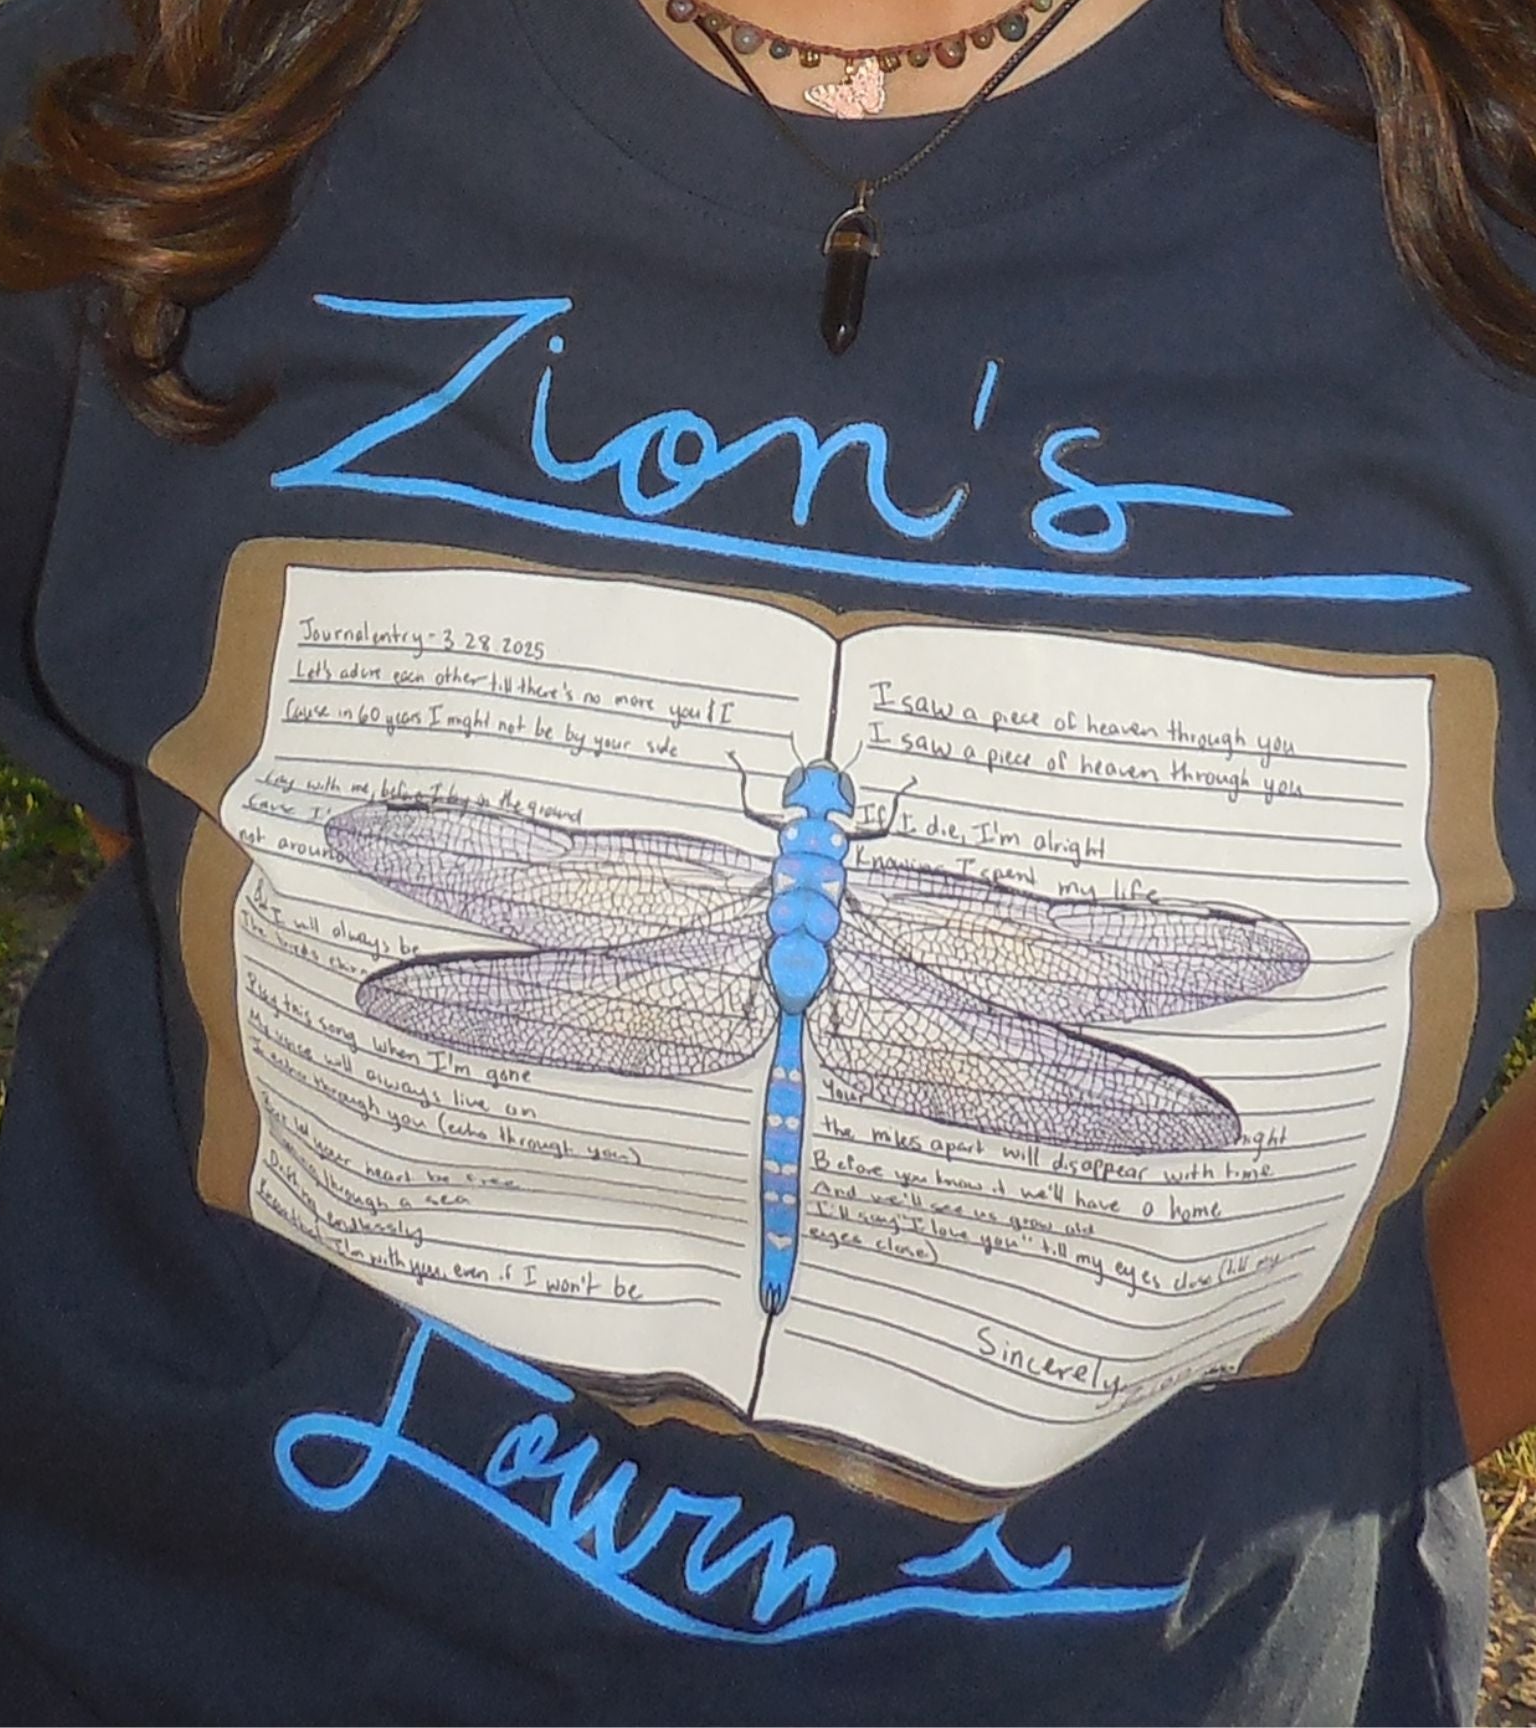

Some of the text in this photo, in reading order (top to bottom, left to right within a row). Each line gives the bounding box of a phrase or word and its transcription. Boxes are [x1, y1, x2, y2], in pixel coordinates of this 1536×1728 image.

[271, 293, 1470, 598] Zion's
[296, 658, 332, 680] Let's
[340, 662, 381, 680] adore
[393, 670, 424, 685] each
[435, 666, 488, 686] other
[490, 671, 512, 693] till
[517, 676, 574, 703] there's
[583, 690, 601, 705] no
[614, 692, 655, 711] more
[669, 704, 700, 730] you
[720, 701, 735, 724] I
[339, 706, 353, 720] in
[358, 703, 380, 724] 60
[385, 711, 422, 737] years
[429, 703, 443, 727] I
[447, 708, 490, 739] might
[498, 714, 526, 734] not
[535, 716, 553, 740] be
[566, 723, 586, 756] by
[594, 737, 632, 757] your
[646, 735, 678, 758] side
[869, 680, 1295, 769] I saw a piece of heaven through you
[868, 720, 1305, 806] I saw a piece of heaven through you
[306, 775, 341, 793] with
[500, 789, 521, 813] the
[527, 797, 582, 825] ground
[239, 826, 265, 844] not
[900, 811, 916, 833] I
[970, 819, 1021, 846] I'm
[1032, 829, 1107, 868] alright
[955, 856, 976, 875] I
[977, 866, 1038, 889] spent
[1057, 879, 1097, 901] my
[1113, 878, 1161, 905] life
[271, 906, 285, 926] I
[293, 916, 320, 933] will
[332, 920, 390, 962] always
[318, 1016, 358, 1054] song
[427, 1050, 471, 1077] I'm
[486, 1068, 532, 1090] gone
[324, 1053, 353, 1073] will
[366, 1068, 441, 1109] always
[452, 1090, 490, 1112] live
[505, 1102, 537, 1119] on
[387, 1110, 427, 1133] you
[499, 1125, 574, 1159] through
[823, 1114, 856, 1139] the
[871, 1125, 922, 1152] miles
[929, 1138, 985, 1163] apart
[1002, 1145, 1041, 1168] will
[1052, 1150, 1150, 1183] disappear
[1163, 1162, 1215, 1184] with
[365, 1158, 411, 1183] heart
[812, 1148, 885, 1177] Before
[894, 1167, 928, 1188] you
[936, 1168, 983, 1192] know
[991, 1179, 1007, 1195] it
[1020, 1182, 1064, 1204] we'll
[1075, 1188, 1121, 1213] have
[1169, 1194, 1222, 1222] home
[399, 1197, 412, 1210] a
[812, 1179, 858, 1200] And
[869, 1191, 922, 1209] we'll
[1008, 1215, 1054, 1232] grow
[369, 1245, 405, 1268] with
[453, 1265, 489, 1282] even
[498, 1265, 511, 1282] if
[523, 1264, 537, 1286] I
[546, 1271, 600, 1296] won't
[613, 1272, 644, 1300] be
[809, 1227, 938, 1264] eyes close)
[816, 1199, 850, 1220] I'll
[930, 1217, 968, 1239] love
[1042, 1238, 1068, 1258] till
[1075, 1253, 1103, 1286] my
[1114, 1261, 1161, 1298] eyes
